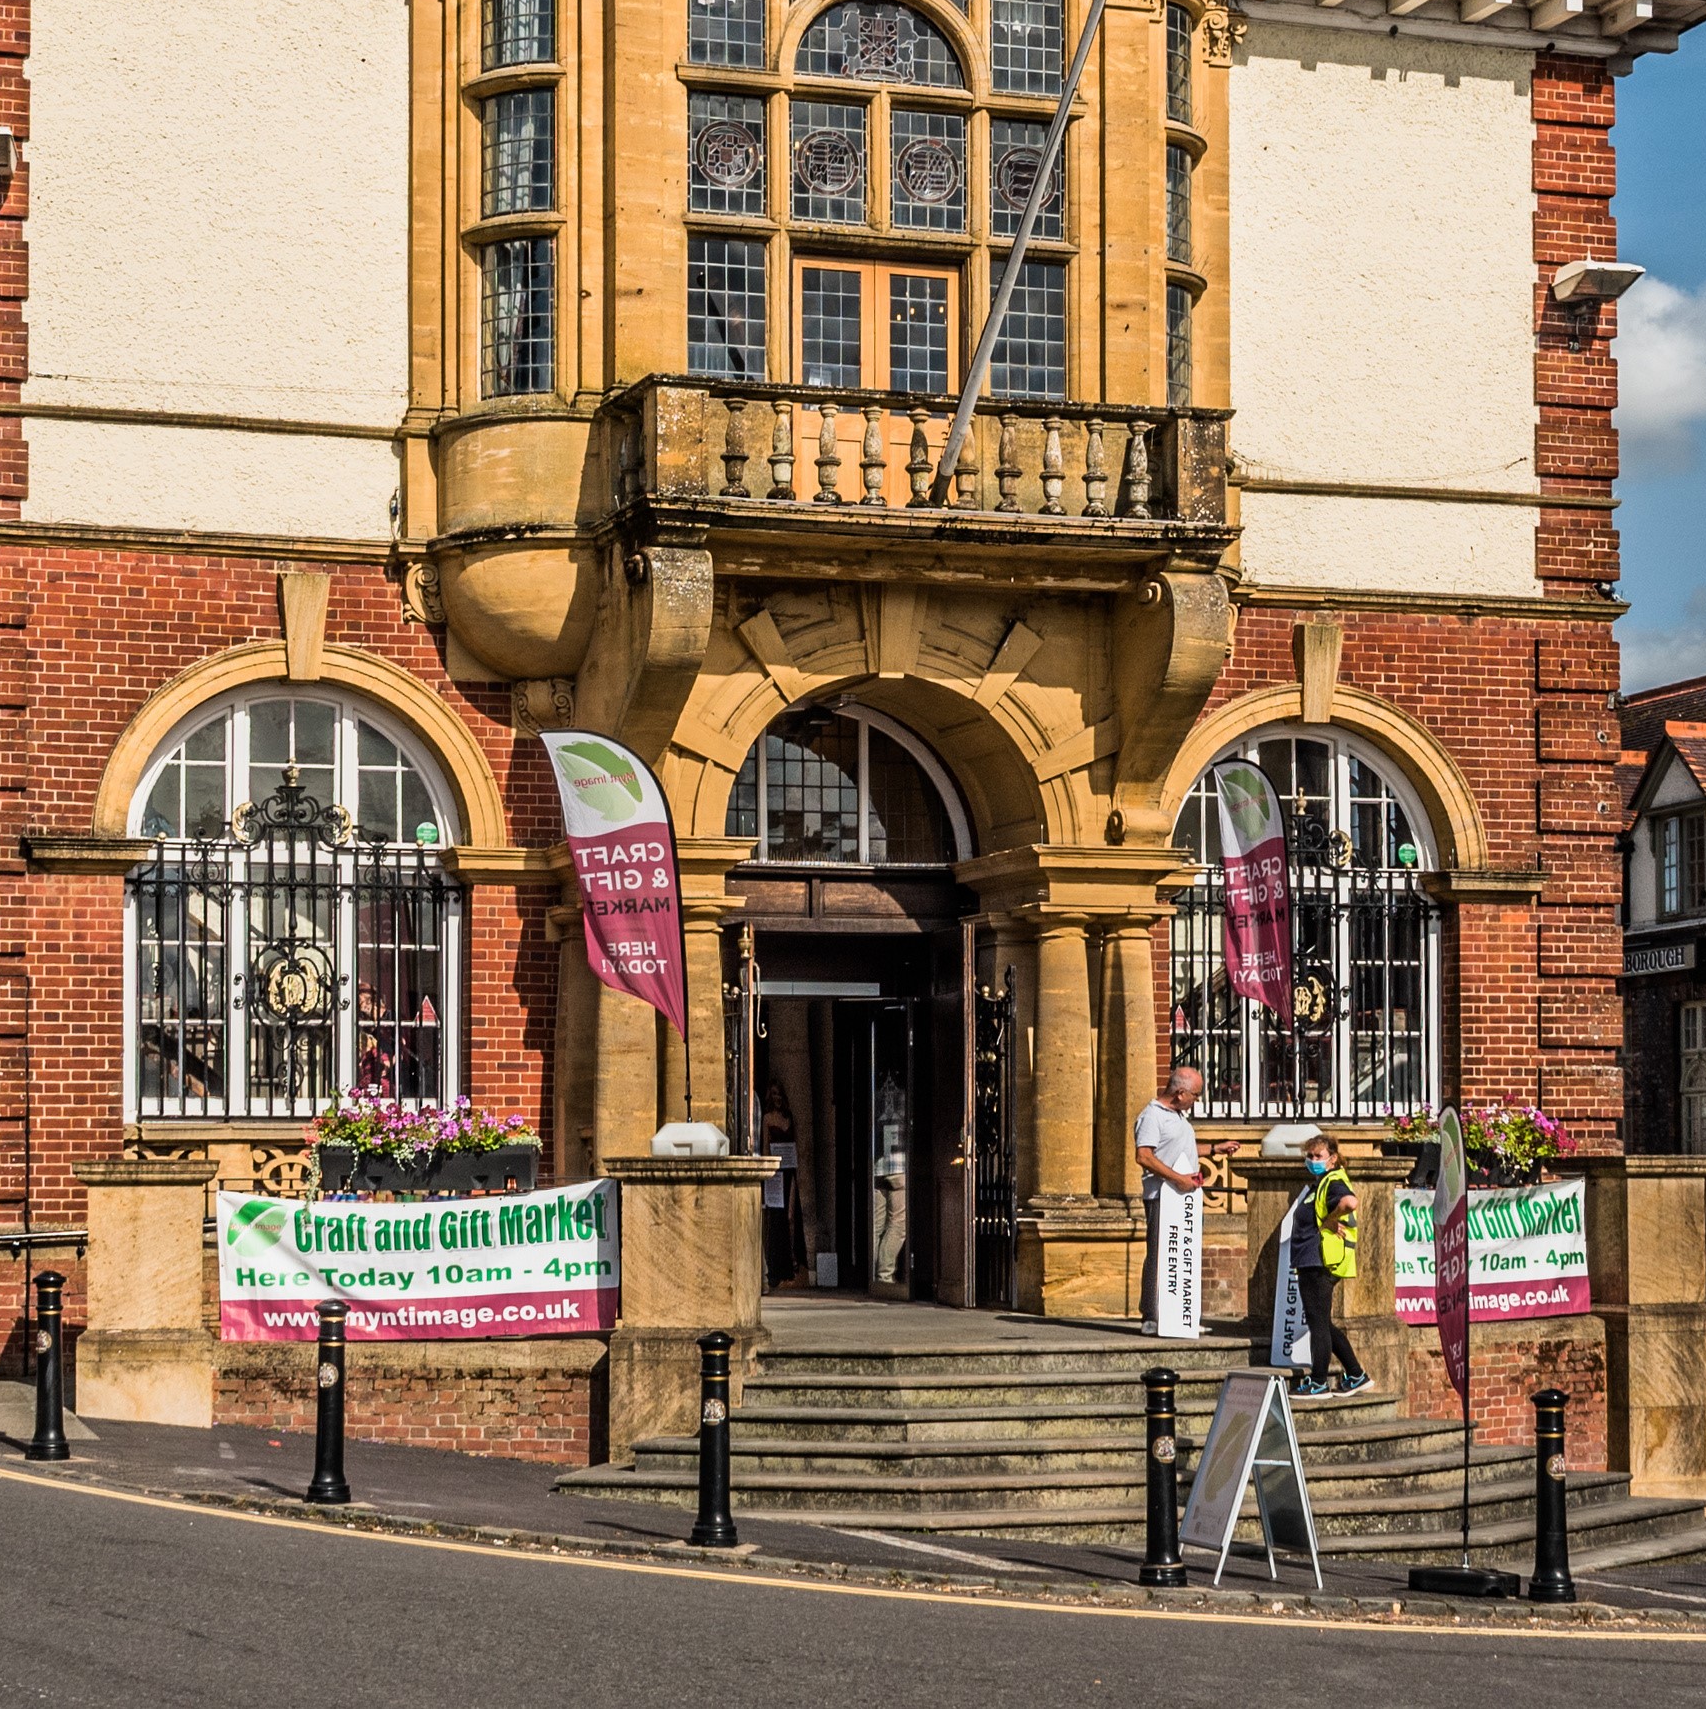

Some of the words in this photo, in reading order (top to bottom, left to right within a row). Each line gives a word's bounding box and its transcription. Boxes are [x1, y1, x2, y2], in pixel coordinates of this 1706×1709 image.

[294, 1208, 369, 1253] Craft
[375, 1212, 432, 1252] and
[439, 1208, 493, 1250] Gift
[499, 1192, 606, 1246] Market
[1185, 1195, 1194, 1233] CRAFT
[1400, 1198, 1435, 1243] Cra
[1516, 1192, 1582, 1237] Market
[1169, 1225, 1178, 1254] FREE
[1184, 1236, 1193, 1245] &
[236, 1267, 311, 1287] Here
[318, 1267, 414, 1290] Today
[427, 1264, 512, 1284] 10am
[544, 1257, 612, 1282] 4pm
[1168, 1259, 1178, 1296] ENTRY
[1183, 1248, 1193, 1275] GIFT
[1394, 1261, 1415, 1275] ere
[1479, 1253, 1526, 1272] 10am
[1546, 1249, 1585, 1270] 4pm
[1182, 1278, 1192, 1328] MARKET
[1287, 1278, 1298, 1304] GIFT
[1286, 1307, 1296, 1317] &
[1283, 1321, 1295, 1357] CRAFT
